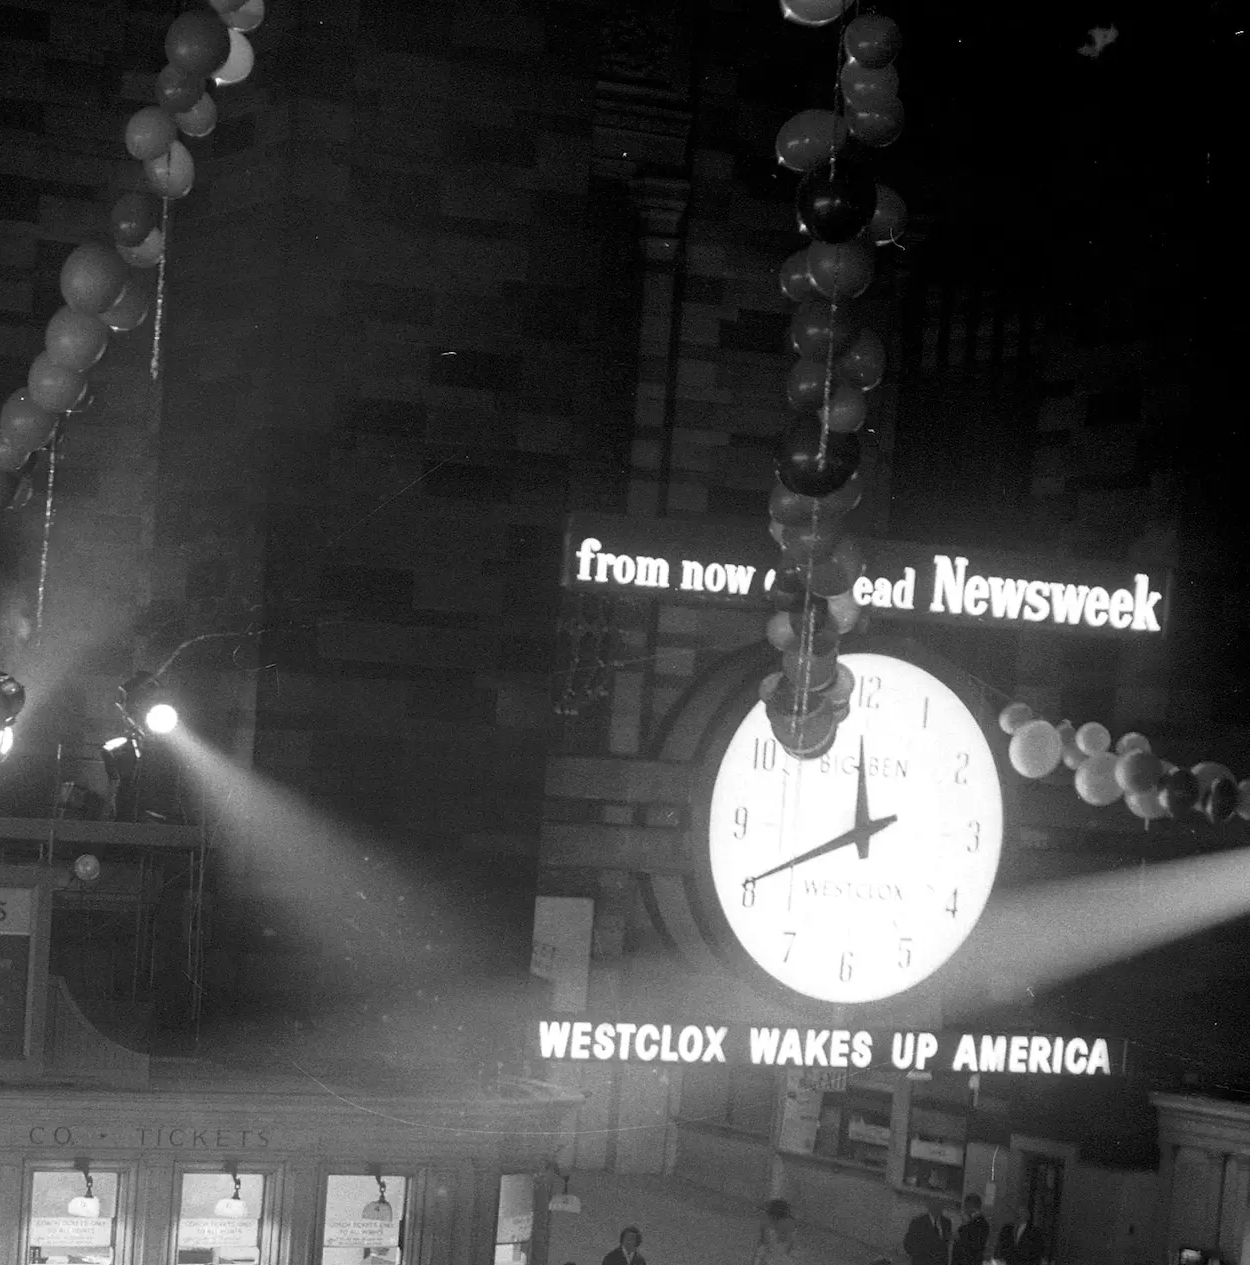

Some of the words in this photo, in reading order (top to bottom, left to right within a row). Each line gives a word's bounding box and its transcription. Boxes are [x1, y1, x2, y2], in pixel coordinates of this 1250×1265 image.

[576, 537, 670, 588] from
[680, 560, 756, 595] now
[852, 567, 916, 610] ead
[930, 554, 1163, 632] Newsweek
[752, 735, 778, 773] 10
[868, 756, 910, 780] BEN
[954, 750, 971, 788] 2
[732, 805, 749, 840] 9
[964, 820, 982, 854] 3
[803, 878, 904, 901] WESTCLOX
[943, 886, 958, 920] 4
[780, 930, 797, 964] 7
[898, 936, 914, 970] 5
[838, 950, 855, 984] 6
[539, 1021, 729, 1063] WESTCLOX
[750, 1027, 873, 1068] WAKES
[891, 1032, 939, 1070] UP
[952, 1034, 1111, 1075] AMERICA
[136, 1128, 269, 1148] TICKETS
